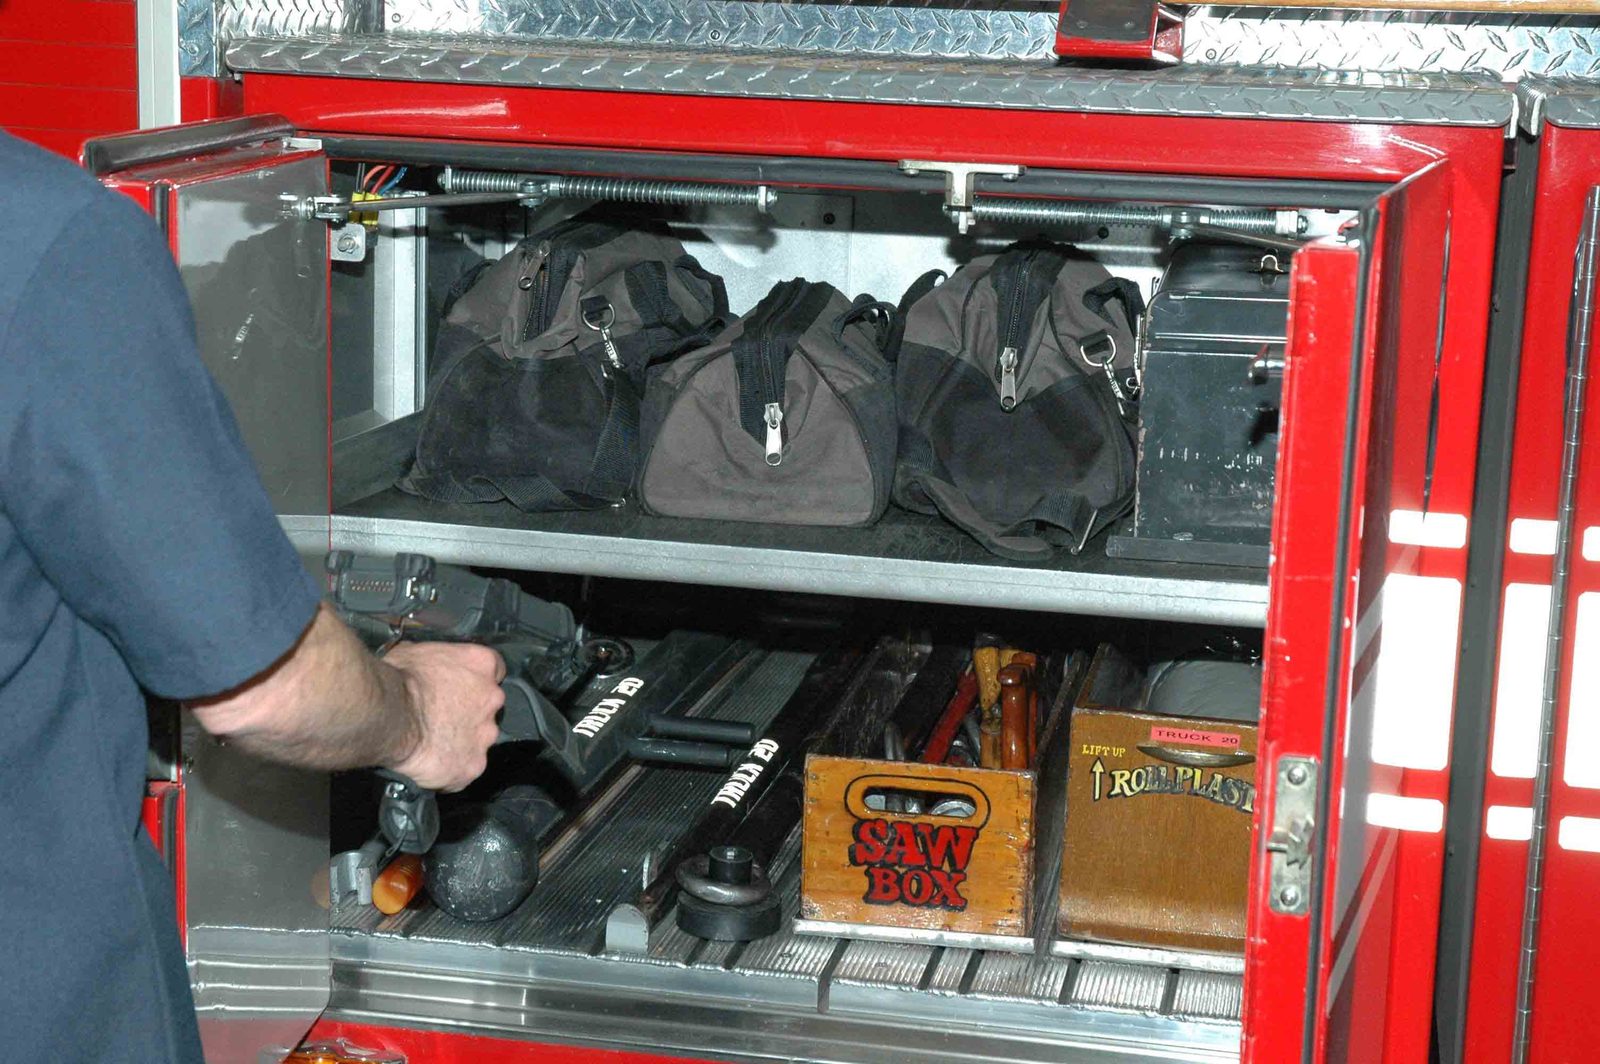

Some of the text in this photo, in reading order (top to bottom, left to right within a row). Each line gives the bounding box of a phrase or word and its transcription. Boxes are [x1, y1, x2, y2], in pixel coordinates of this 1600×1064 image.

[572, 677, 645, 738] TRUCK 20
[1082, 744, 1126, 757] LIFT UP
[1157, 729, 1239, 745] TRUCK 20
[711, 738, 780, 808] TRUCK 20
[1108, 765, 1169, 799] ROLL
[849, 818, 980, 870] SAW
[864, 867, 968, 911] BOX
